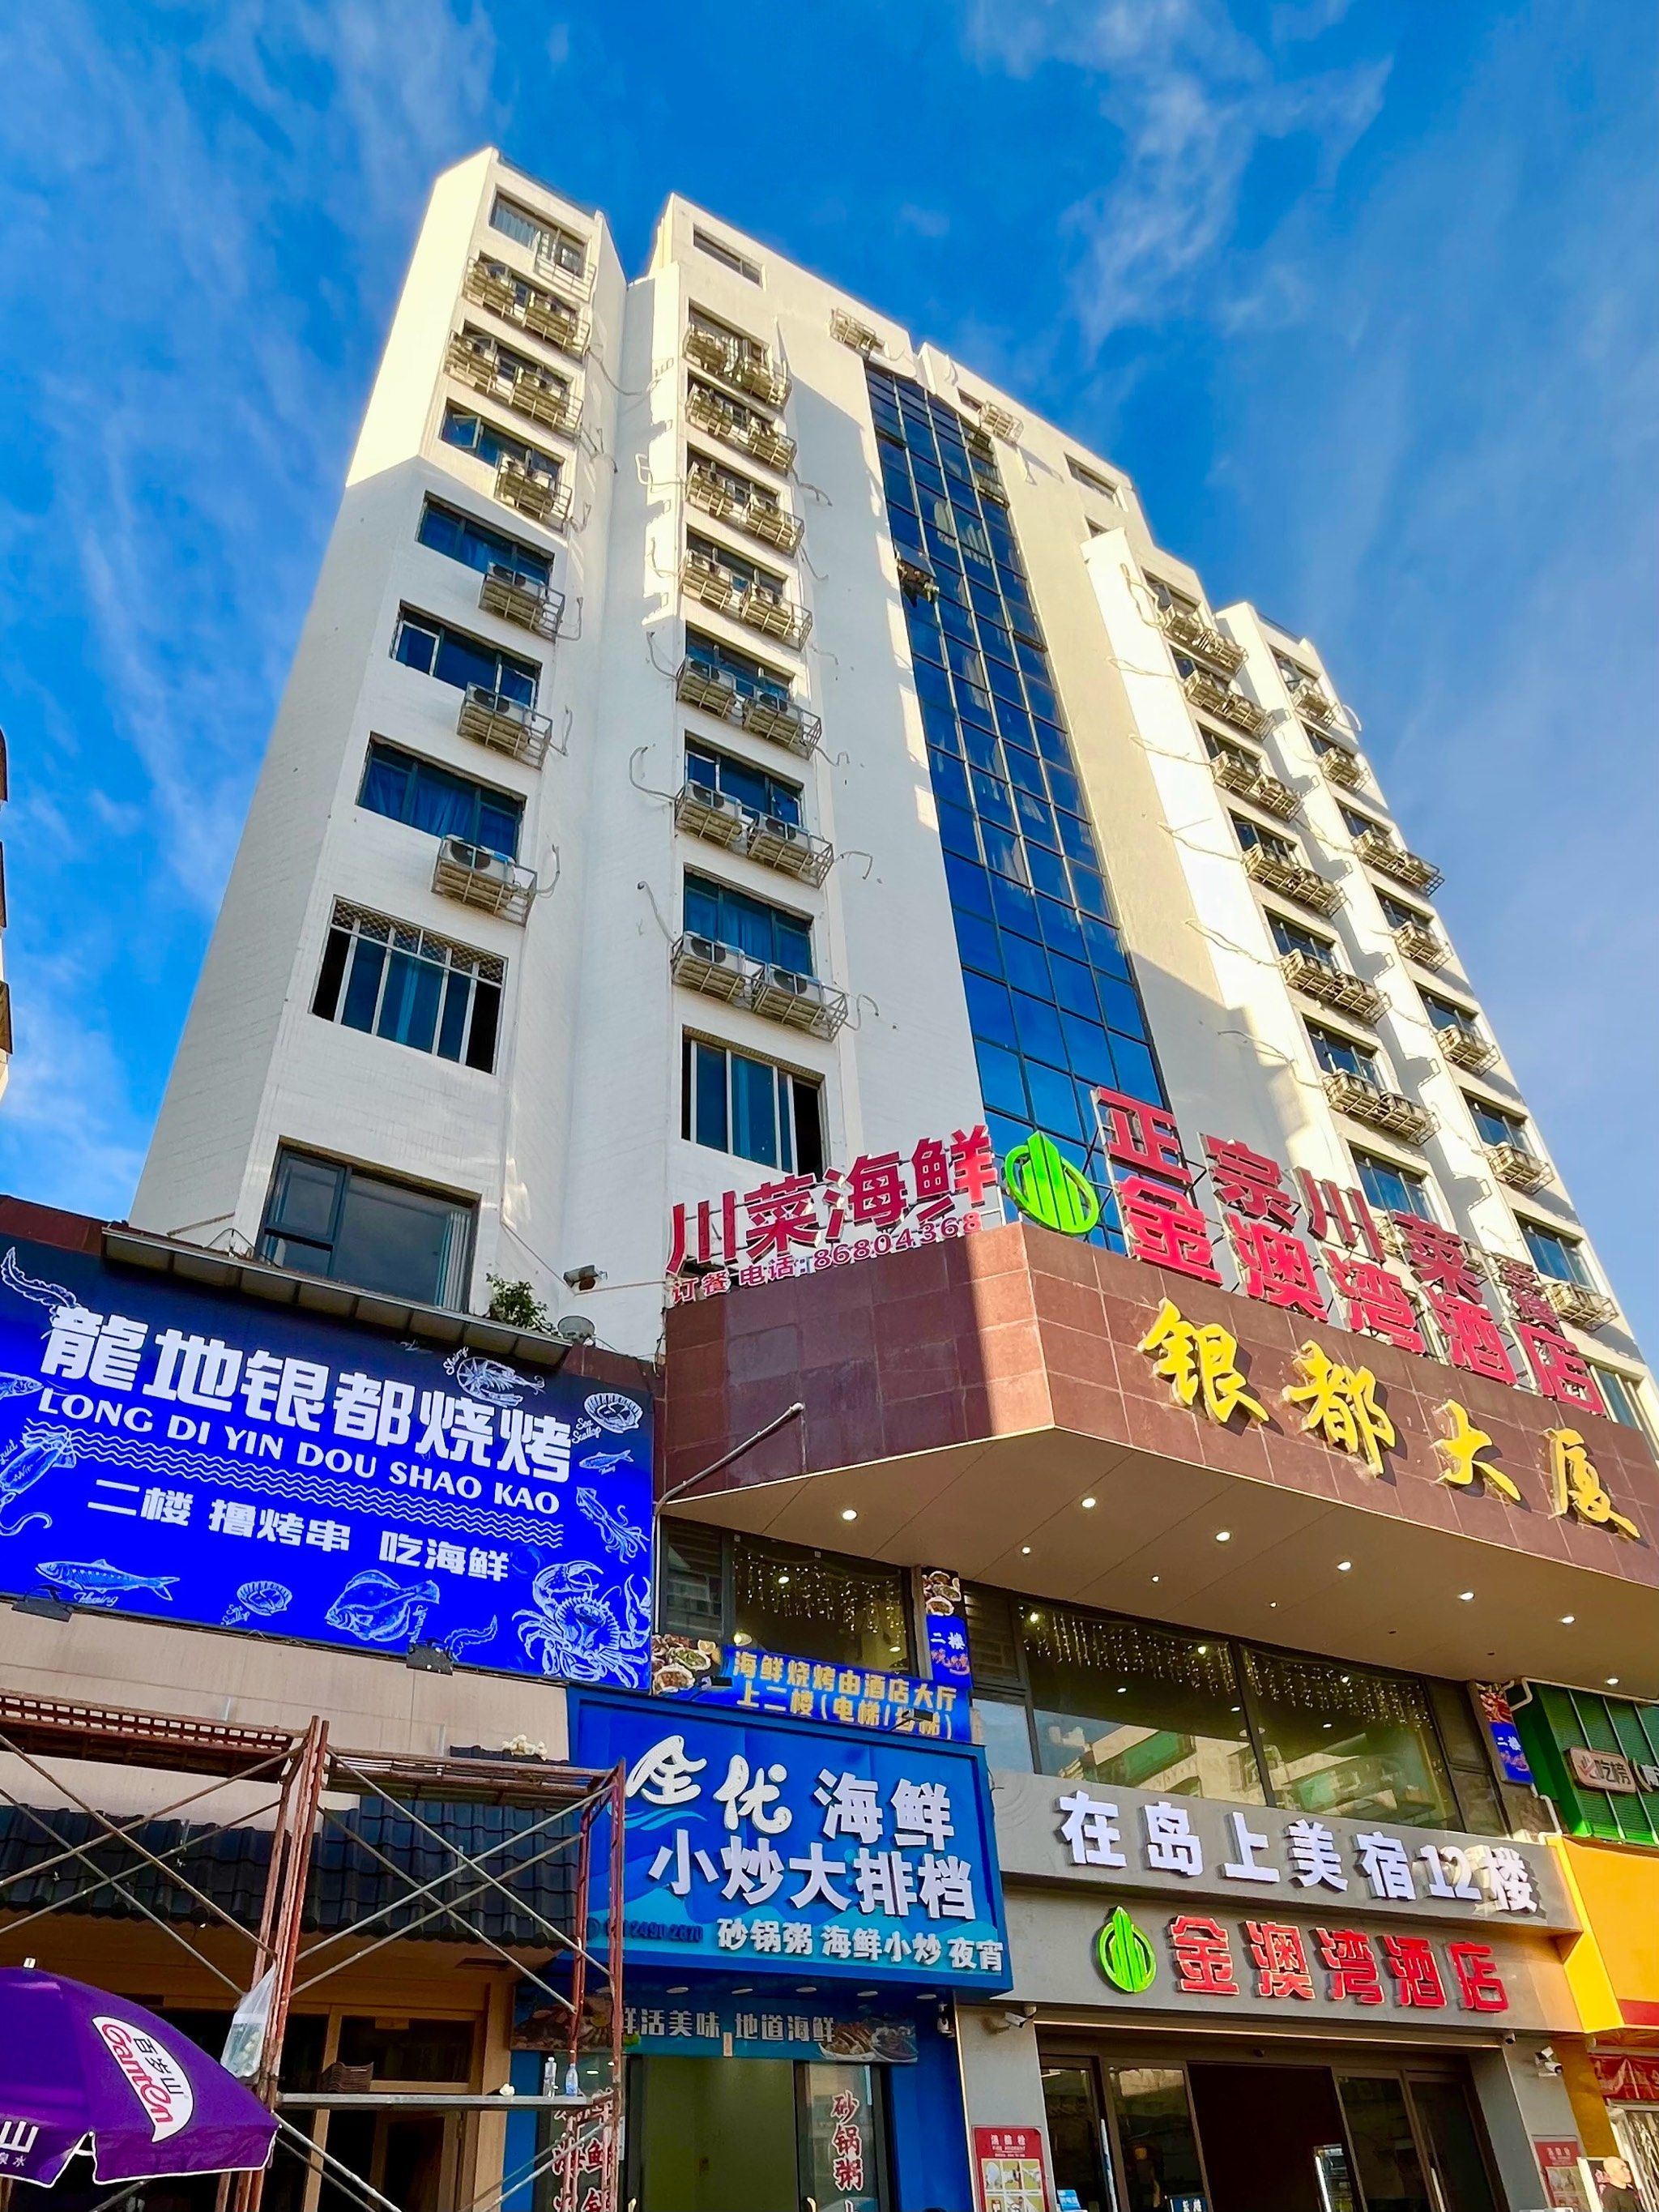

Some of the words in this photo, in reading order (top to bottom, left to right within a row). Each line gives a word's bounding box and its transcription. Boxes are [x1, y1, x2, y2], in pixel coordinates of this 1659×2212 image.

[666, 1125, 998, 1275] 川菜海鲜
[1116, 1175, 1606, 1418] 金澳湾酒店
[41, 1306, 571, 1484] 龍地银都烧烤
[1138, 1298, 1641, 1541] 银都大厦
[39, 1388, 153, 1433] LONG
[167, 1415, 211, 1445] DI
[224, 1425, 284, 1460] YIN
[296, 1441, 377, 1479] DOU
[389, 1461, 482, 1500] SHAO
[494, 1482, 560, 1514] KAO
[87, 1479, 194, 1527] 二楼
[208, 1498, 351, 1552] 撸烤串
[379, 1531, 510, 1582] 吃海鲜
[733, 1651, 957, 1712] 海鲜烧烤由酒店大厅
[813, 1768, 955, 1851] 海鲜
[1057, 1789, 1539, 1914] 在岛上美宿12楼
[648, 1829, 977, 1920] 小炒大排档
[717, 1918, 813, 1955] 砂锅粥
[821, 1924, 942, 1966] 海鲜小炒
[948, 1937, 1004, 1972] 夜宵
[1170, 1914, 1510, 2013] 金澳湾酒店
[134, 2038, 184, 2095] 百岁山
[734, 2012, 838, 2043] 地道海鲜
[830, 2089, 864, 2192] 砂锅粥
